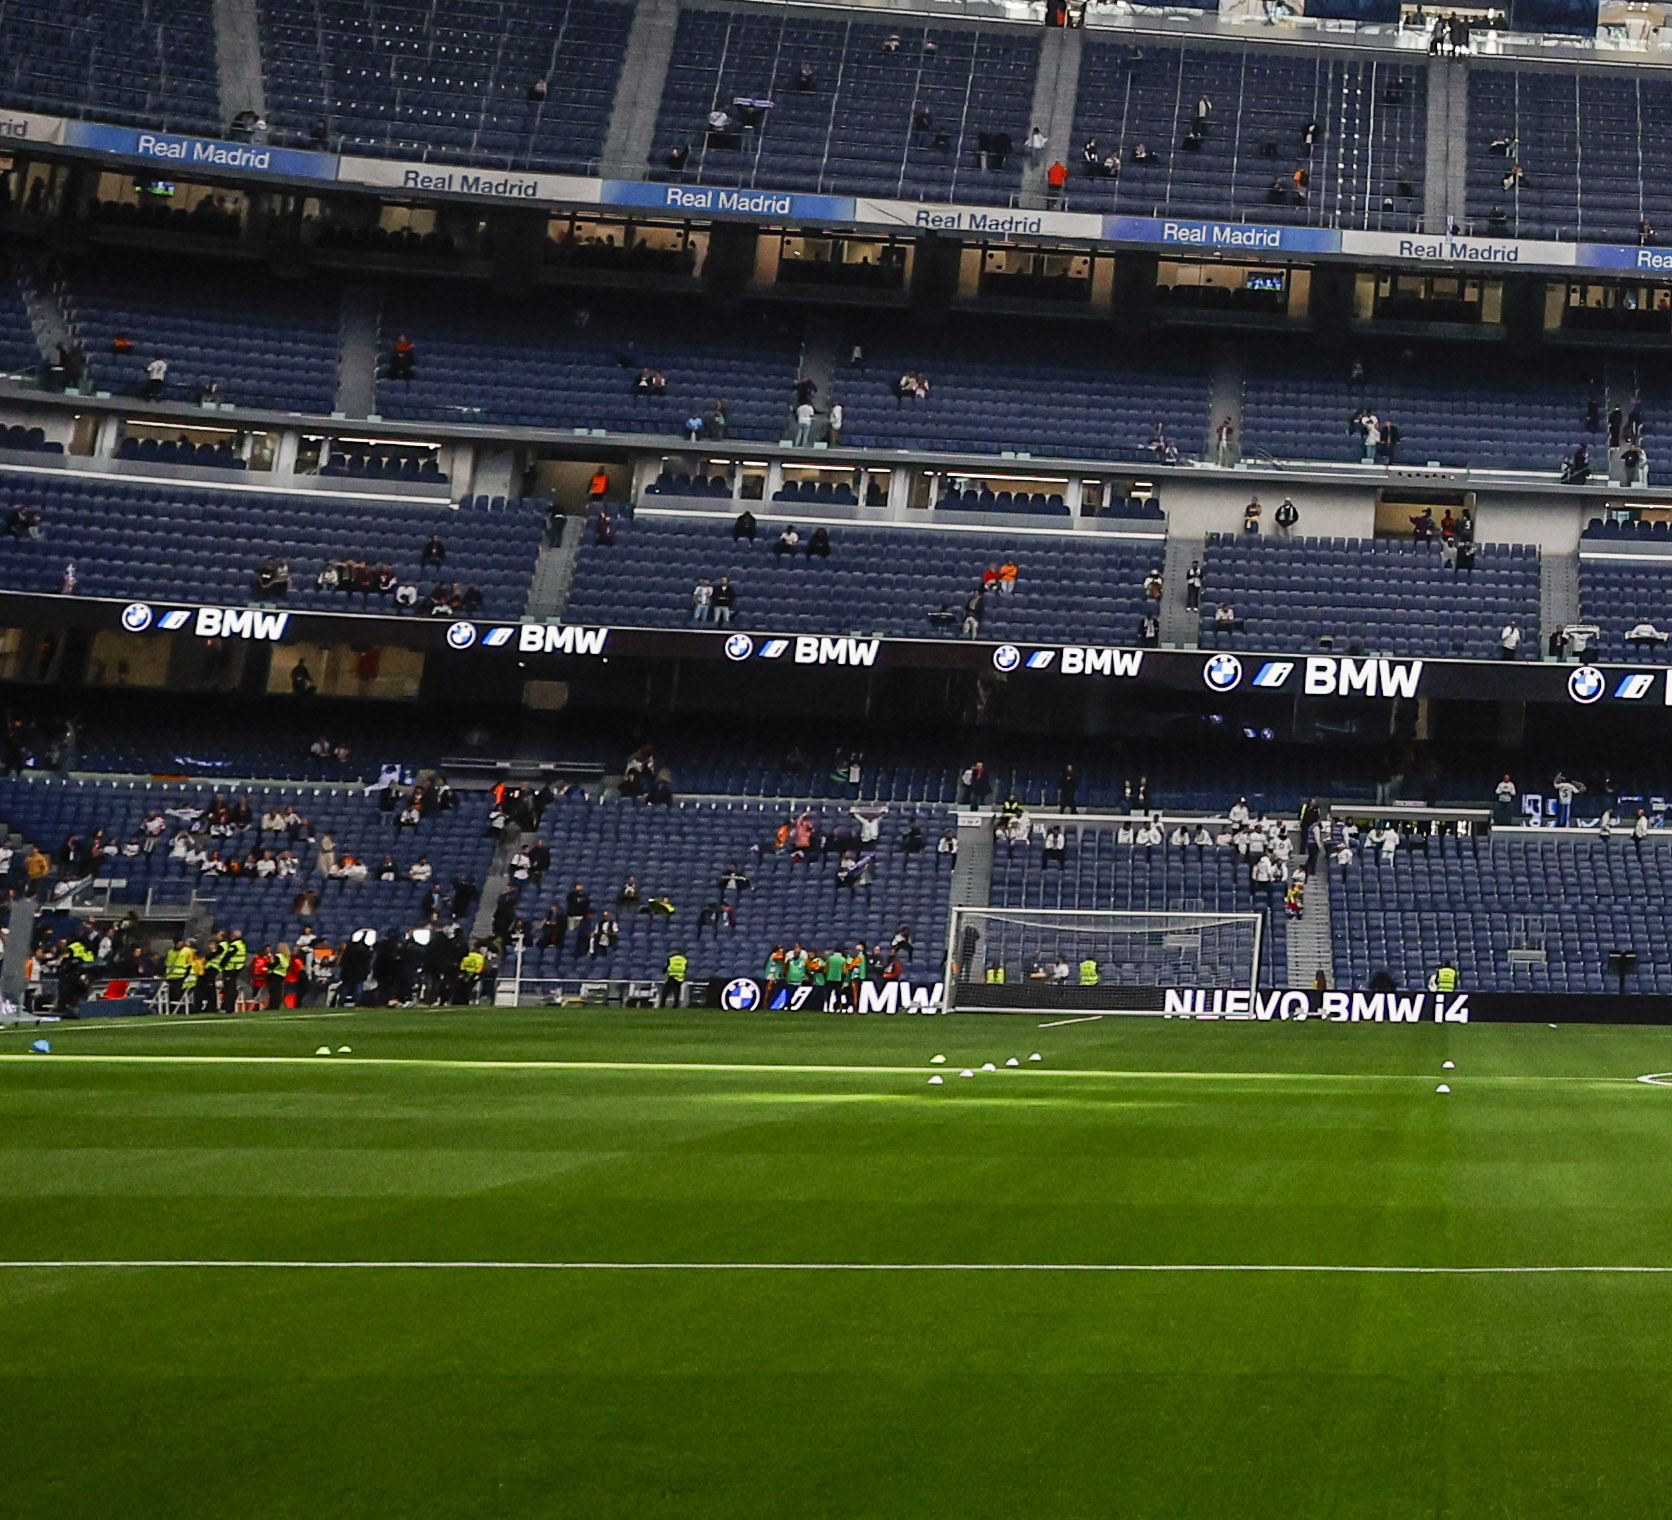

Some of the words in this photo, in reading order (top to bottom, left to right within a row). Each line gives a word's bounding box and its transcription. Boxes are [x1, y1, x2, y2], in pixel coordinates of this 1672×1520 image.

[137, 134, 186, 159] Real
[193, 142, 270, 170] Madrid
[402, 169, 452, 191] Real
[462, 175, 538, 199] Madrid
[666, 188, 711, 210] Real
[719, 191, 791, 215] Madrid
[915, 210, 962, 230] Real
[969, 213, 1042, 234] Madrid
[1163, 223, 1208, 244] Real
[1213, 226, 1281, 248] Madrid
[1399, 240, 1445, 259] Real
[1450, 243, 1519, 262] Madrid
[194, 608, 289, 640] BMW
[518, 624, 608, 655] BMW
[794, 637, 880, 667] BMW
[1060, 648, 1143, 677] BMW
[1304, 657, 1423, 698] BMW
[1163, 989, 1308, 1020] NUEVO
[1321, 992, 1425, 1023] BMW
[1434, 993, 1470, 1024] i4
